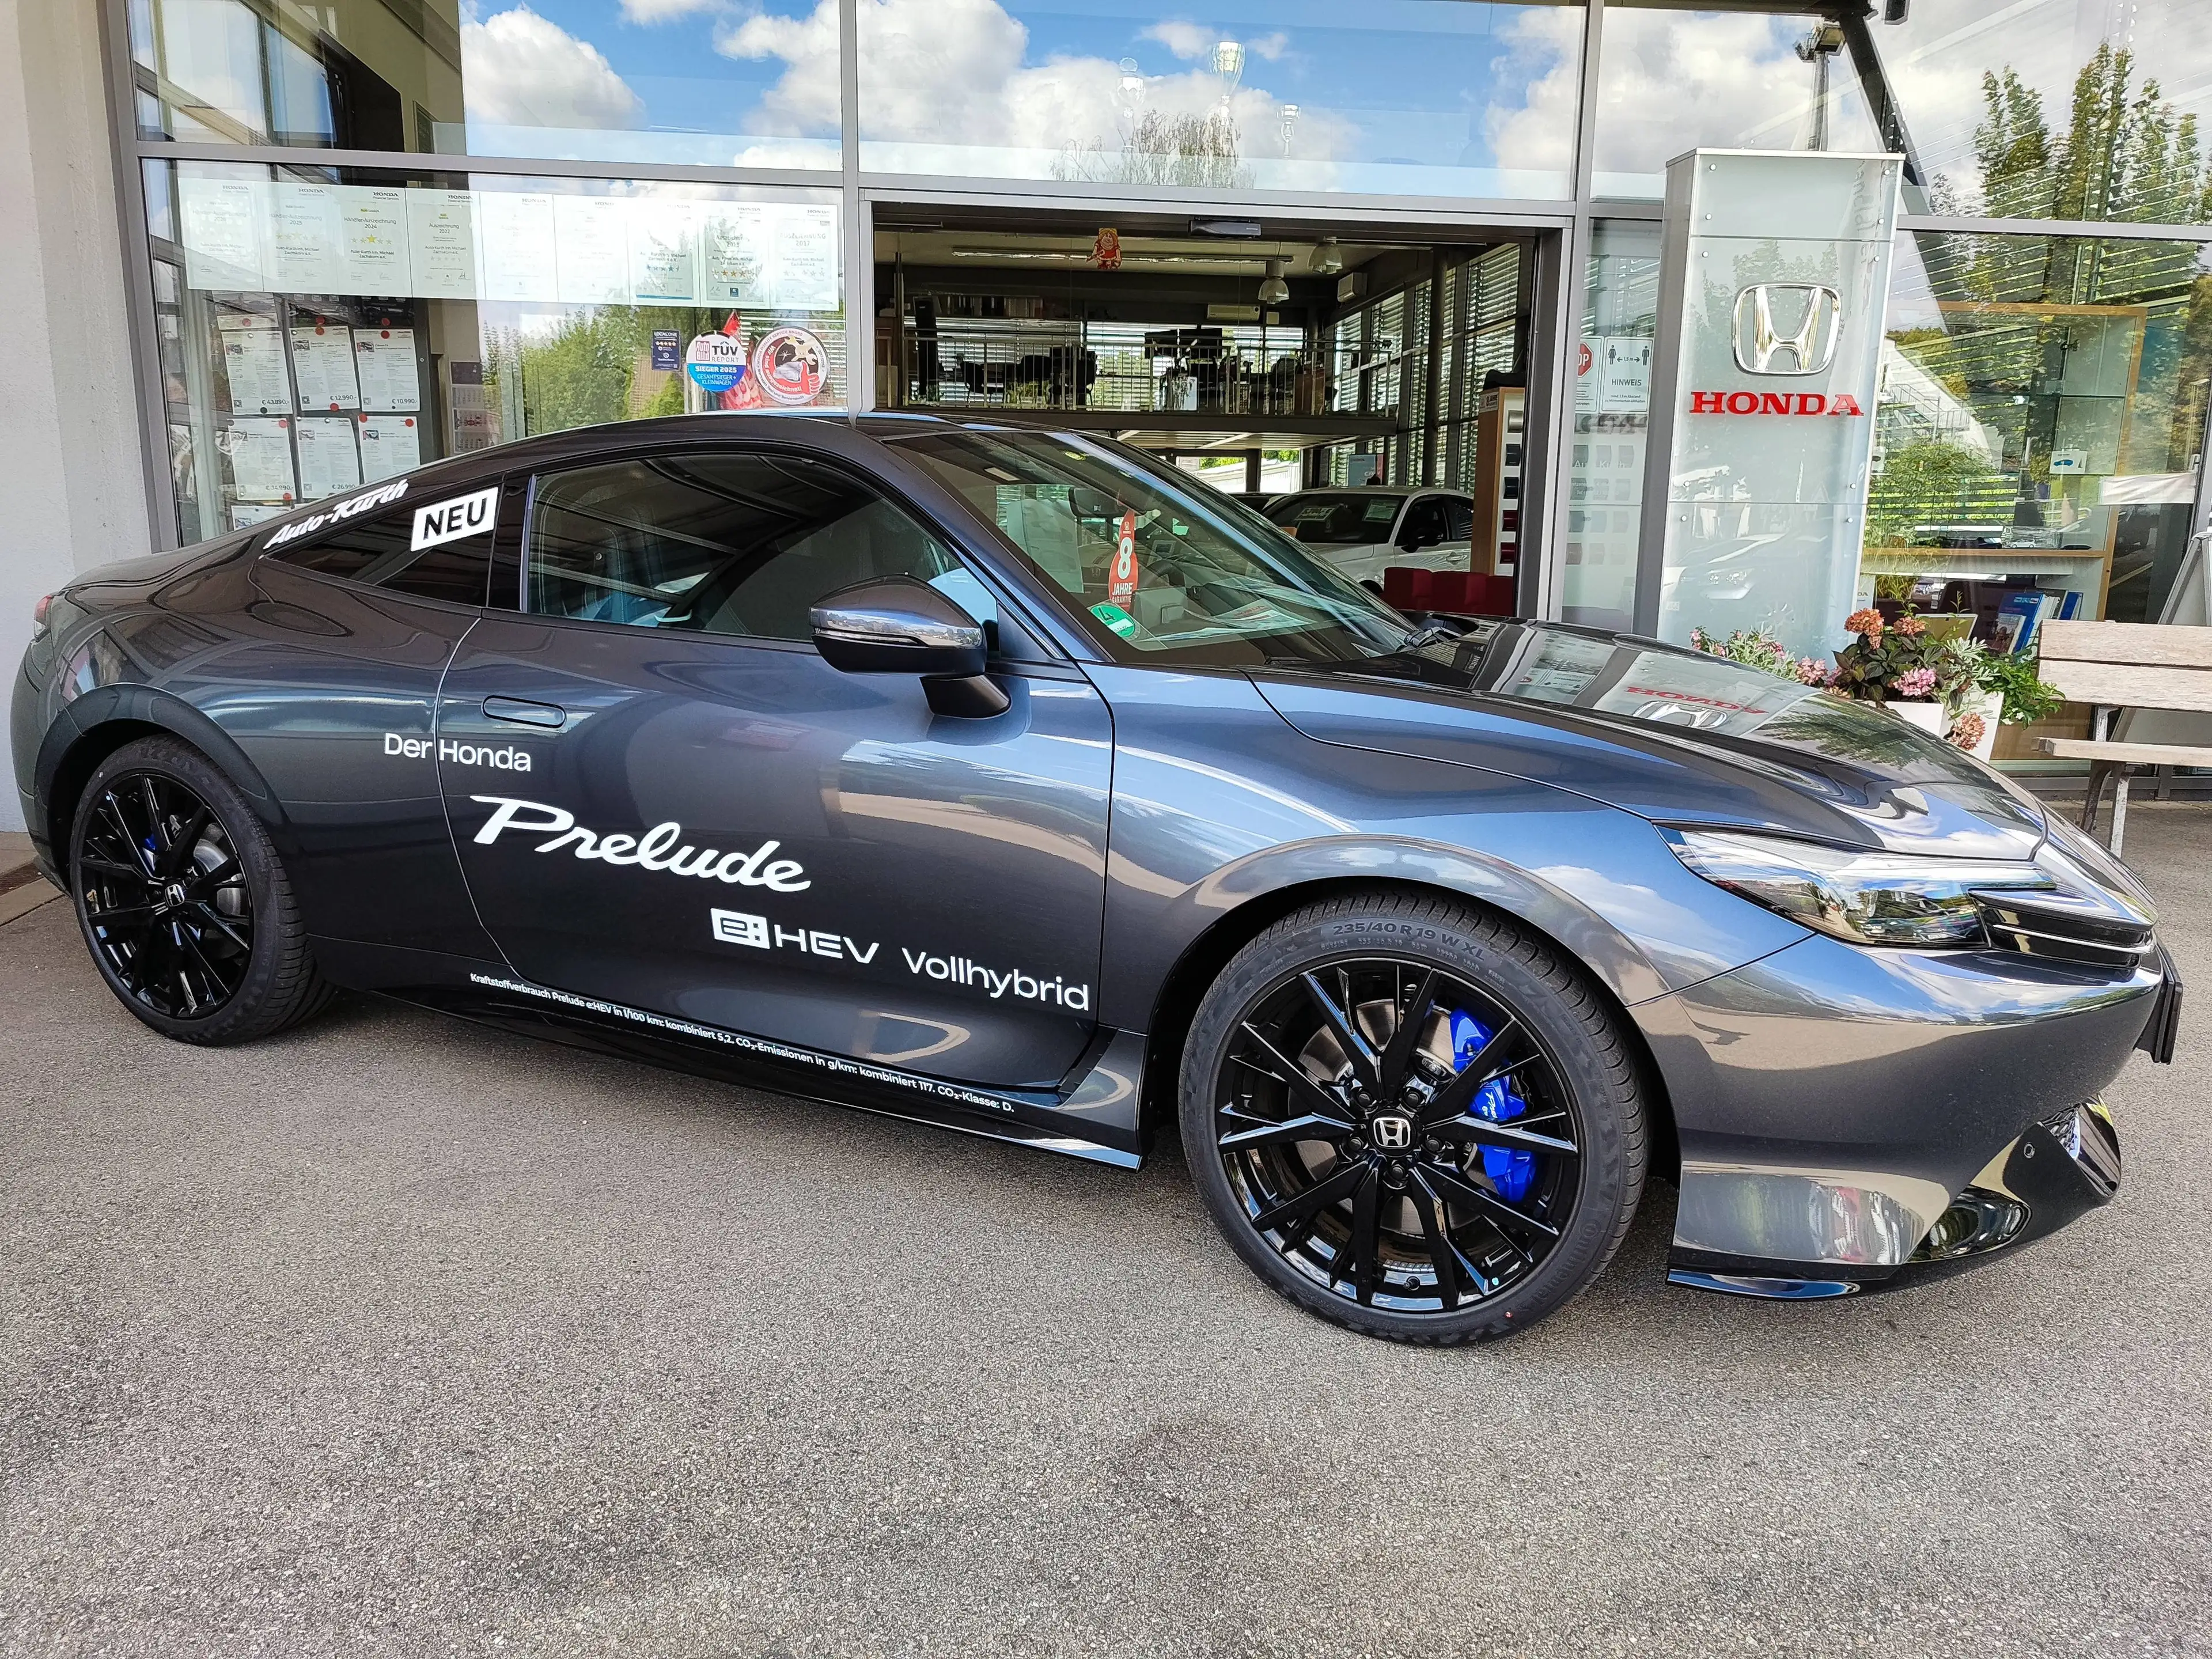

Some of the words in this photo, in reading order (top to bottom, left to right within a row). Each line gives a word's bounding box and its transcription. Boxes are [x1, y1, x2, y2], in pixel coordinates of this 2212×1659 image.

[344, 217, 397, 225] Händler-Auszeichnung
[1611, 378, 1642, 387] HINWEIS
[1689, 391, 1864, 417] HONDA
[263, 478, 409, 550] Auto-Kurth
[423, 497, 488, 541] NEU
[1117, 536, 1133, 580] 8
[1112, 582, 1134, 596] JAHRE
[1112, 595, 1132, 604] GARANTIE
[1098, 607, 1116, 621] 4
[384, 733, 434, 759] Der
[439, 740, 532, 772] Honda
[469, 794, 812, 893] Prelude
[1332, 922, 1397, 936] 235/40
[1400, 924, 1412, 937] R
[1416, 927, 1437, 940] 19
[1441, 933, 1461, 948] W
[1463, 941, 1486, 962] XL
[902, 946, 1090, 1012] Vollhybrid
[470, 973, 551, 999] Kraftstoffverbrauch
[552, 991, 585, 1007] Prelude
[586, 1001, 612, 1014] e:HEV
[613, 1006, 623, 1017] in
[646, 1014, 665, 1028] km:
[665, 1019, 717, 1040] kombiniert
[717, 1031, 735, 1045] 5,2.
[815, 1055, 825, 1067] in
[828, 1059, 858, 1074] g/km:
[859, 1066, 918, 1089] kombiniert
[918, 1080, 935, 1093] 117.
[1002, 1101, 1014, 1113] D.
